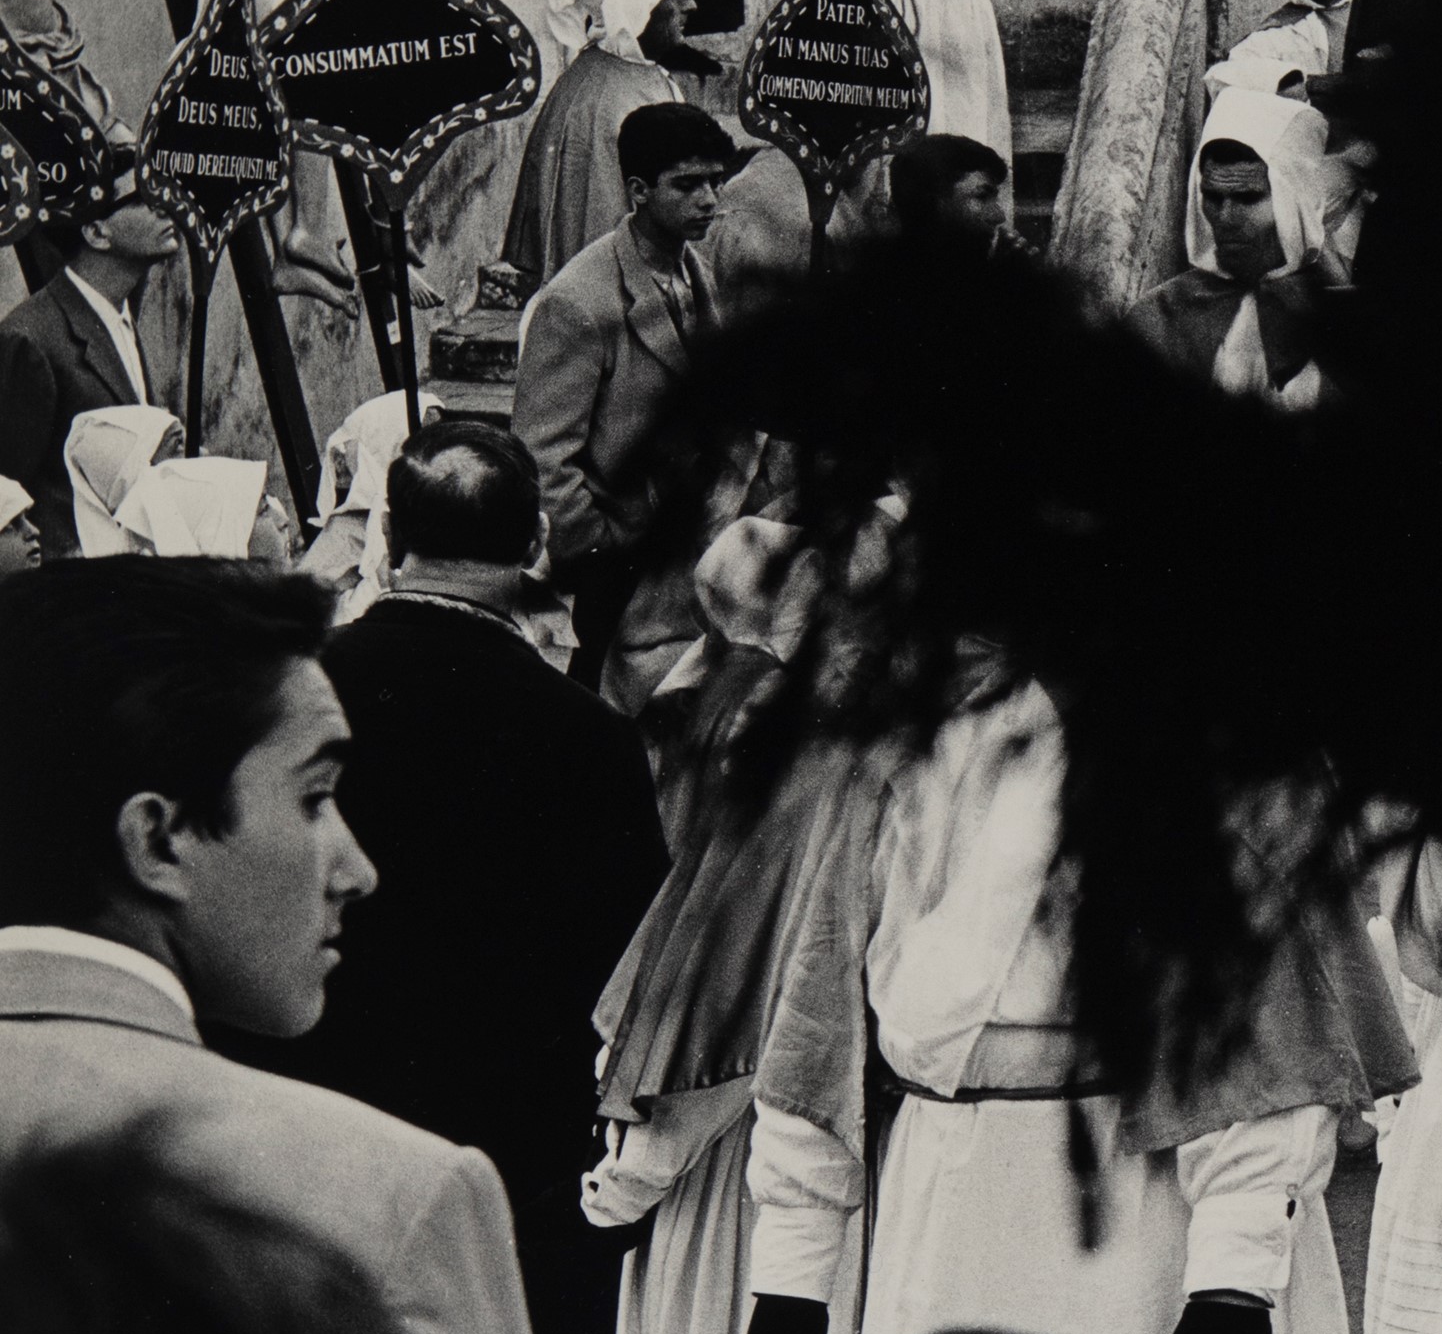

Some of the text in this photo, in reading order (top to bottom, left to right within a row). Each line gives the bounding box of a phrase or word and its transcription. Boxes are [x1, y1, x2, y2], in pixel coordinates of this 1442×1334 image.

[209, 48, 250, 80] DEUS,
[270, 32, 477, 79] CONSUMMATUM EST
[778, 36, 889, 69] IN MANUS TUAS
[759, 73, 910, 110] COMMENDO SPIRITUM MEUM
[178, 95, 262, 131] DEUS MEUS,
[155, 149, 279, 184] UT QUID DERELEQUISTI ME
